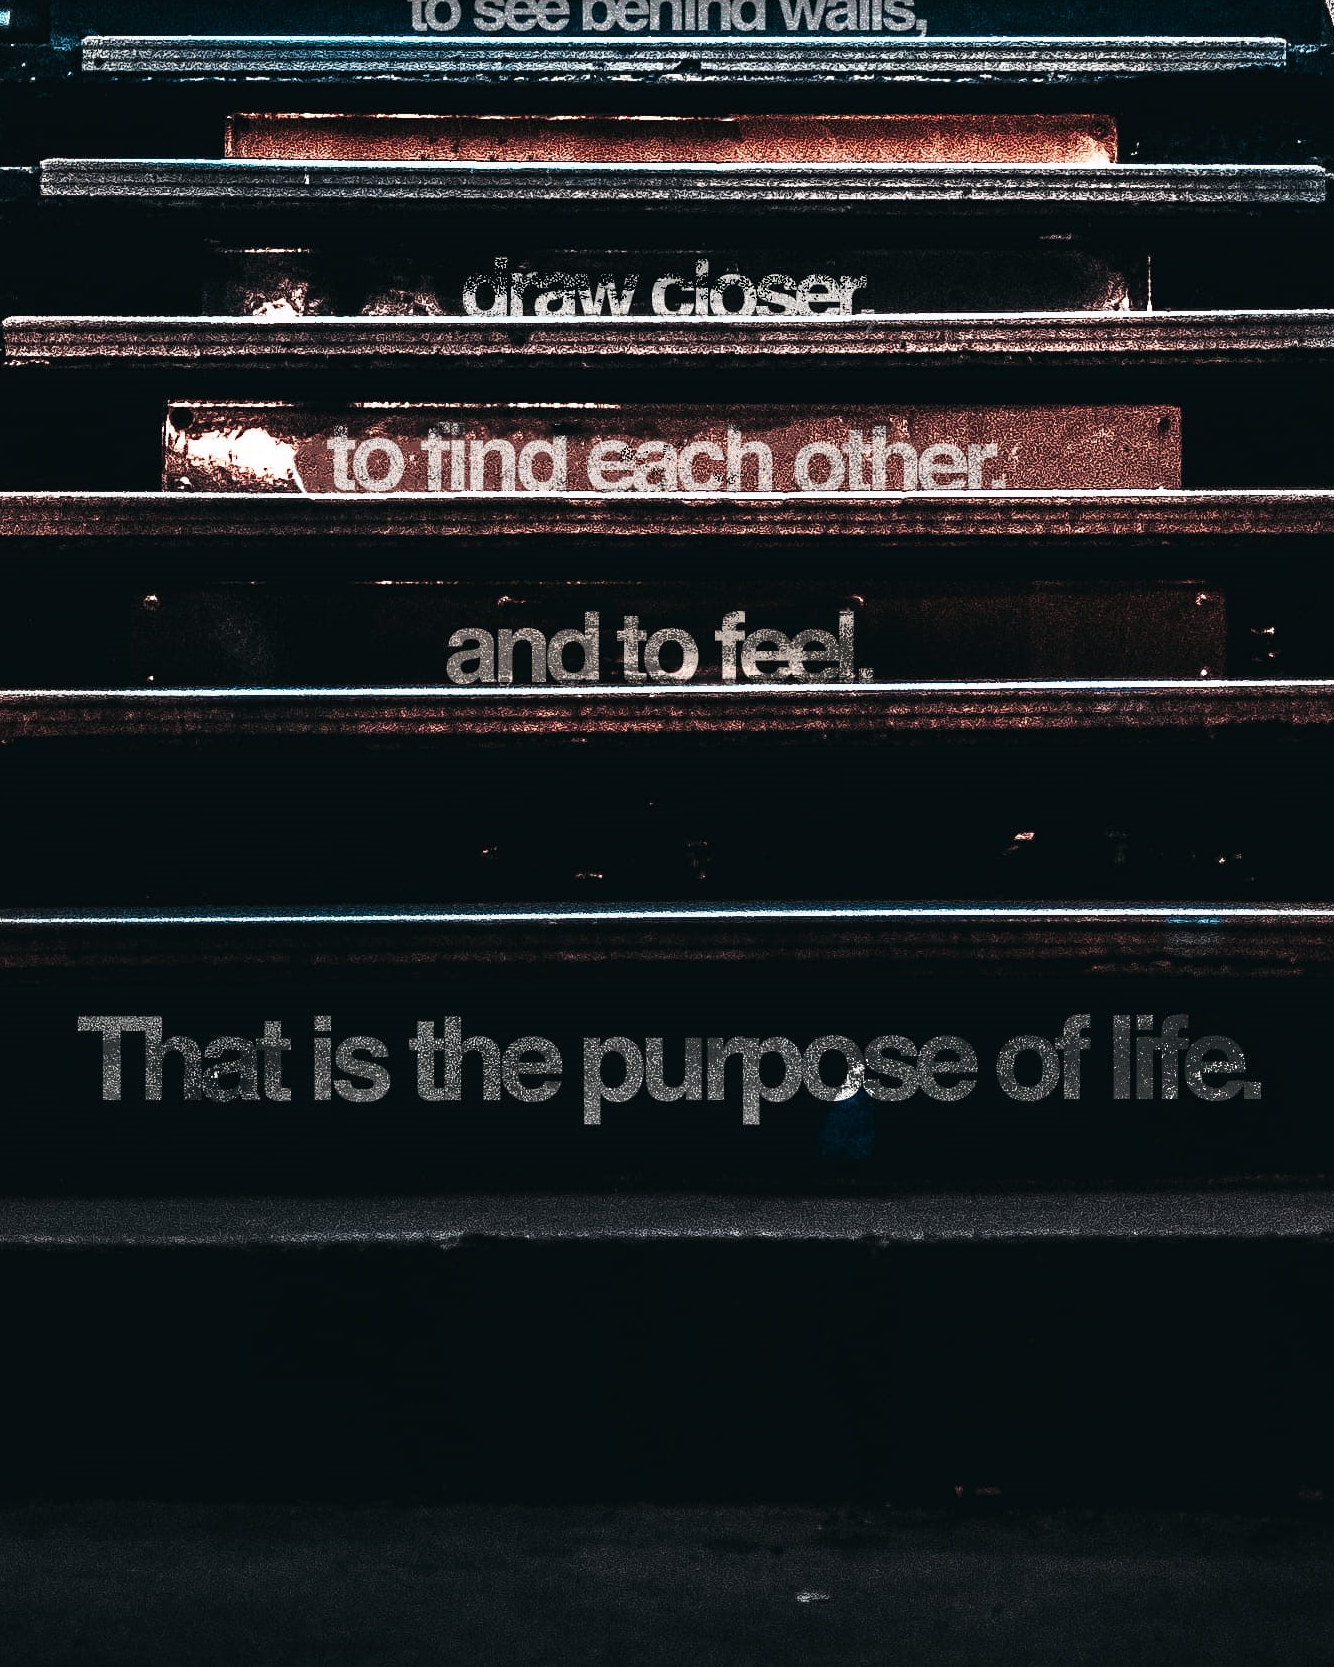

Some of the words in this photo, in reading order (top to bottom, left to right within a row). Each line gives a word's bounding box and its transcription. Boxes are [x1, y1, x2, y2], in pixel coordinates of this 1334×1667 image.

[463, 257, 640, 316] draw
[651, 258, 874, 316] closer.
[326, 426, 405, 492] to
[420, 422, 567, 492] find
[586, 423, 769, 492] each
[793, 425, 1008, 491] other.
[446, 611, 600, 684] and
[617, 615, 699, 683] to
[715, 610, 874, 683] feel.
[77, 1016, 292, 1102] That
[313, 1015, 391, 1102] is
[409, 1015, 563, 1102] the
[583, 1034, 978, 1125] purpose
[996, 1014, 1091, 1102] of
[1113, 1014, 1262, 1102] life.
